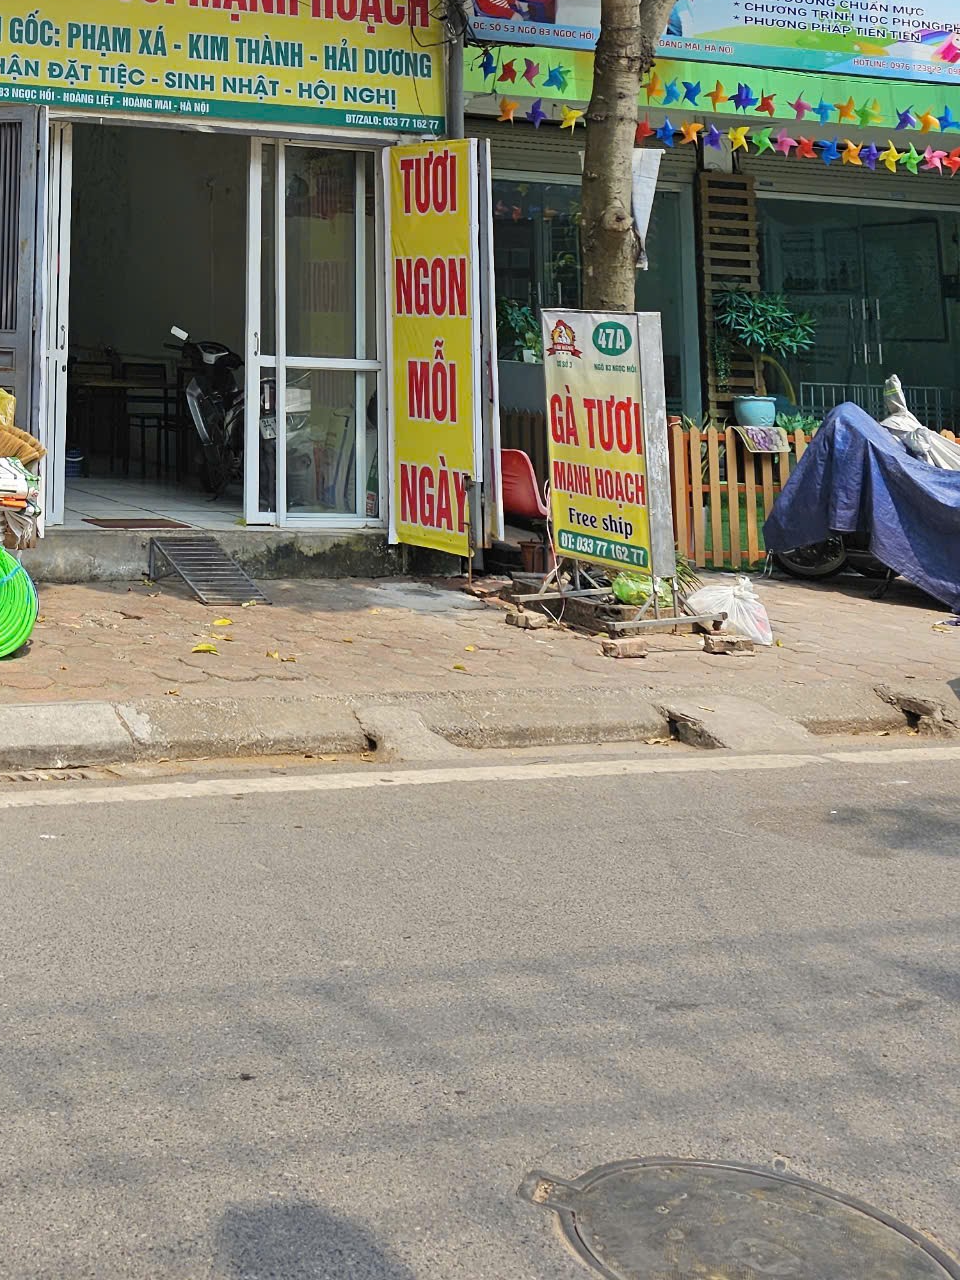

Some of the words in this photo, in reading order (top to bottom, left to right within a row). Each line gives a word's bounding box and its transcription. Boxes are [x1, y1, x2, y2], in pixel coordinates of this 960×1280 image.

[744, 2, 807, 17] CHƯƠNG
[811, 9, 855, 22] TRÌNH
[859, 14, 888, 26] HỌC
[892, 17, 940, 31] PHONG
[744, 15, 807, 30] PHƯƠNG
[811, 22, 851, 34] PHÁP
[893, 5, 925, 17] MỰC
[9, 9, 61, 47] GỐC:
[68, 22, 132, 57] PHẠM
[138, 25, 167, 56] XÁ
[189, 33, 229, 62] KIM
[235, 34, 304, 68] THÀNH
[324, 38, 358, 73] HẢI
[364, 48, 432, 79] DƯƠNG
[504, 24, 515, 32] 53
[539, 28, 551, 36] 83
[48, 59, 93, 85] ĐẶT
[98, 63, 145, 89] TIỆC
[164, 71, 215, 92] SINH
[223, 74, 280, 100] NHẬT
[298, 79, 336, 105] HỘI
[343, 86, 397, 110] NGHỊ
[12, 88, 37, 101] NGỌC
[39, 88, 54, 101] HỒI
[63, 91, 93, 105] HOÀNG
[96, 94, 114, 107] LIỆT
[122, 96, 152, 109] HOÀNG
[155, 99, 172, 110] MAI
[180, 100, 191, 112] HÀ
[194, 102, 210, 115] NỘI
[345, 113, 382, 127] ĐT/ZALO:
[383, 117, 398, 128] 033
[399, 117, 411, 129] 77
[412, 118, 428, 130] 162
[429, 120, 439, 131] 77
[400, 149, 457, 214] TƯƠI
[395, 257, 467, 316] NGON
[597, 328, 626, 350] 47A
[408, 339, 457, 423] MỖI
[550, 384, 580, 447] GÀ
[583, 394, 643, 455] TƯƠI
[400, 455, 469, 533] NGÀY
[553, 460, 592, 499] MẠNH
[594, 467, 646, 509] HOẠCH
[568, 507, 598, 529] Free
[602, 514, 633, 539] ship
[560, 532, 575, 549] ĐT:
[576, 536, 594, 554] 033
[596, 540, 608, 556] 77
[610, 543, 630, 562] 162
[631, 548, 644, 565] 77
